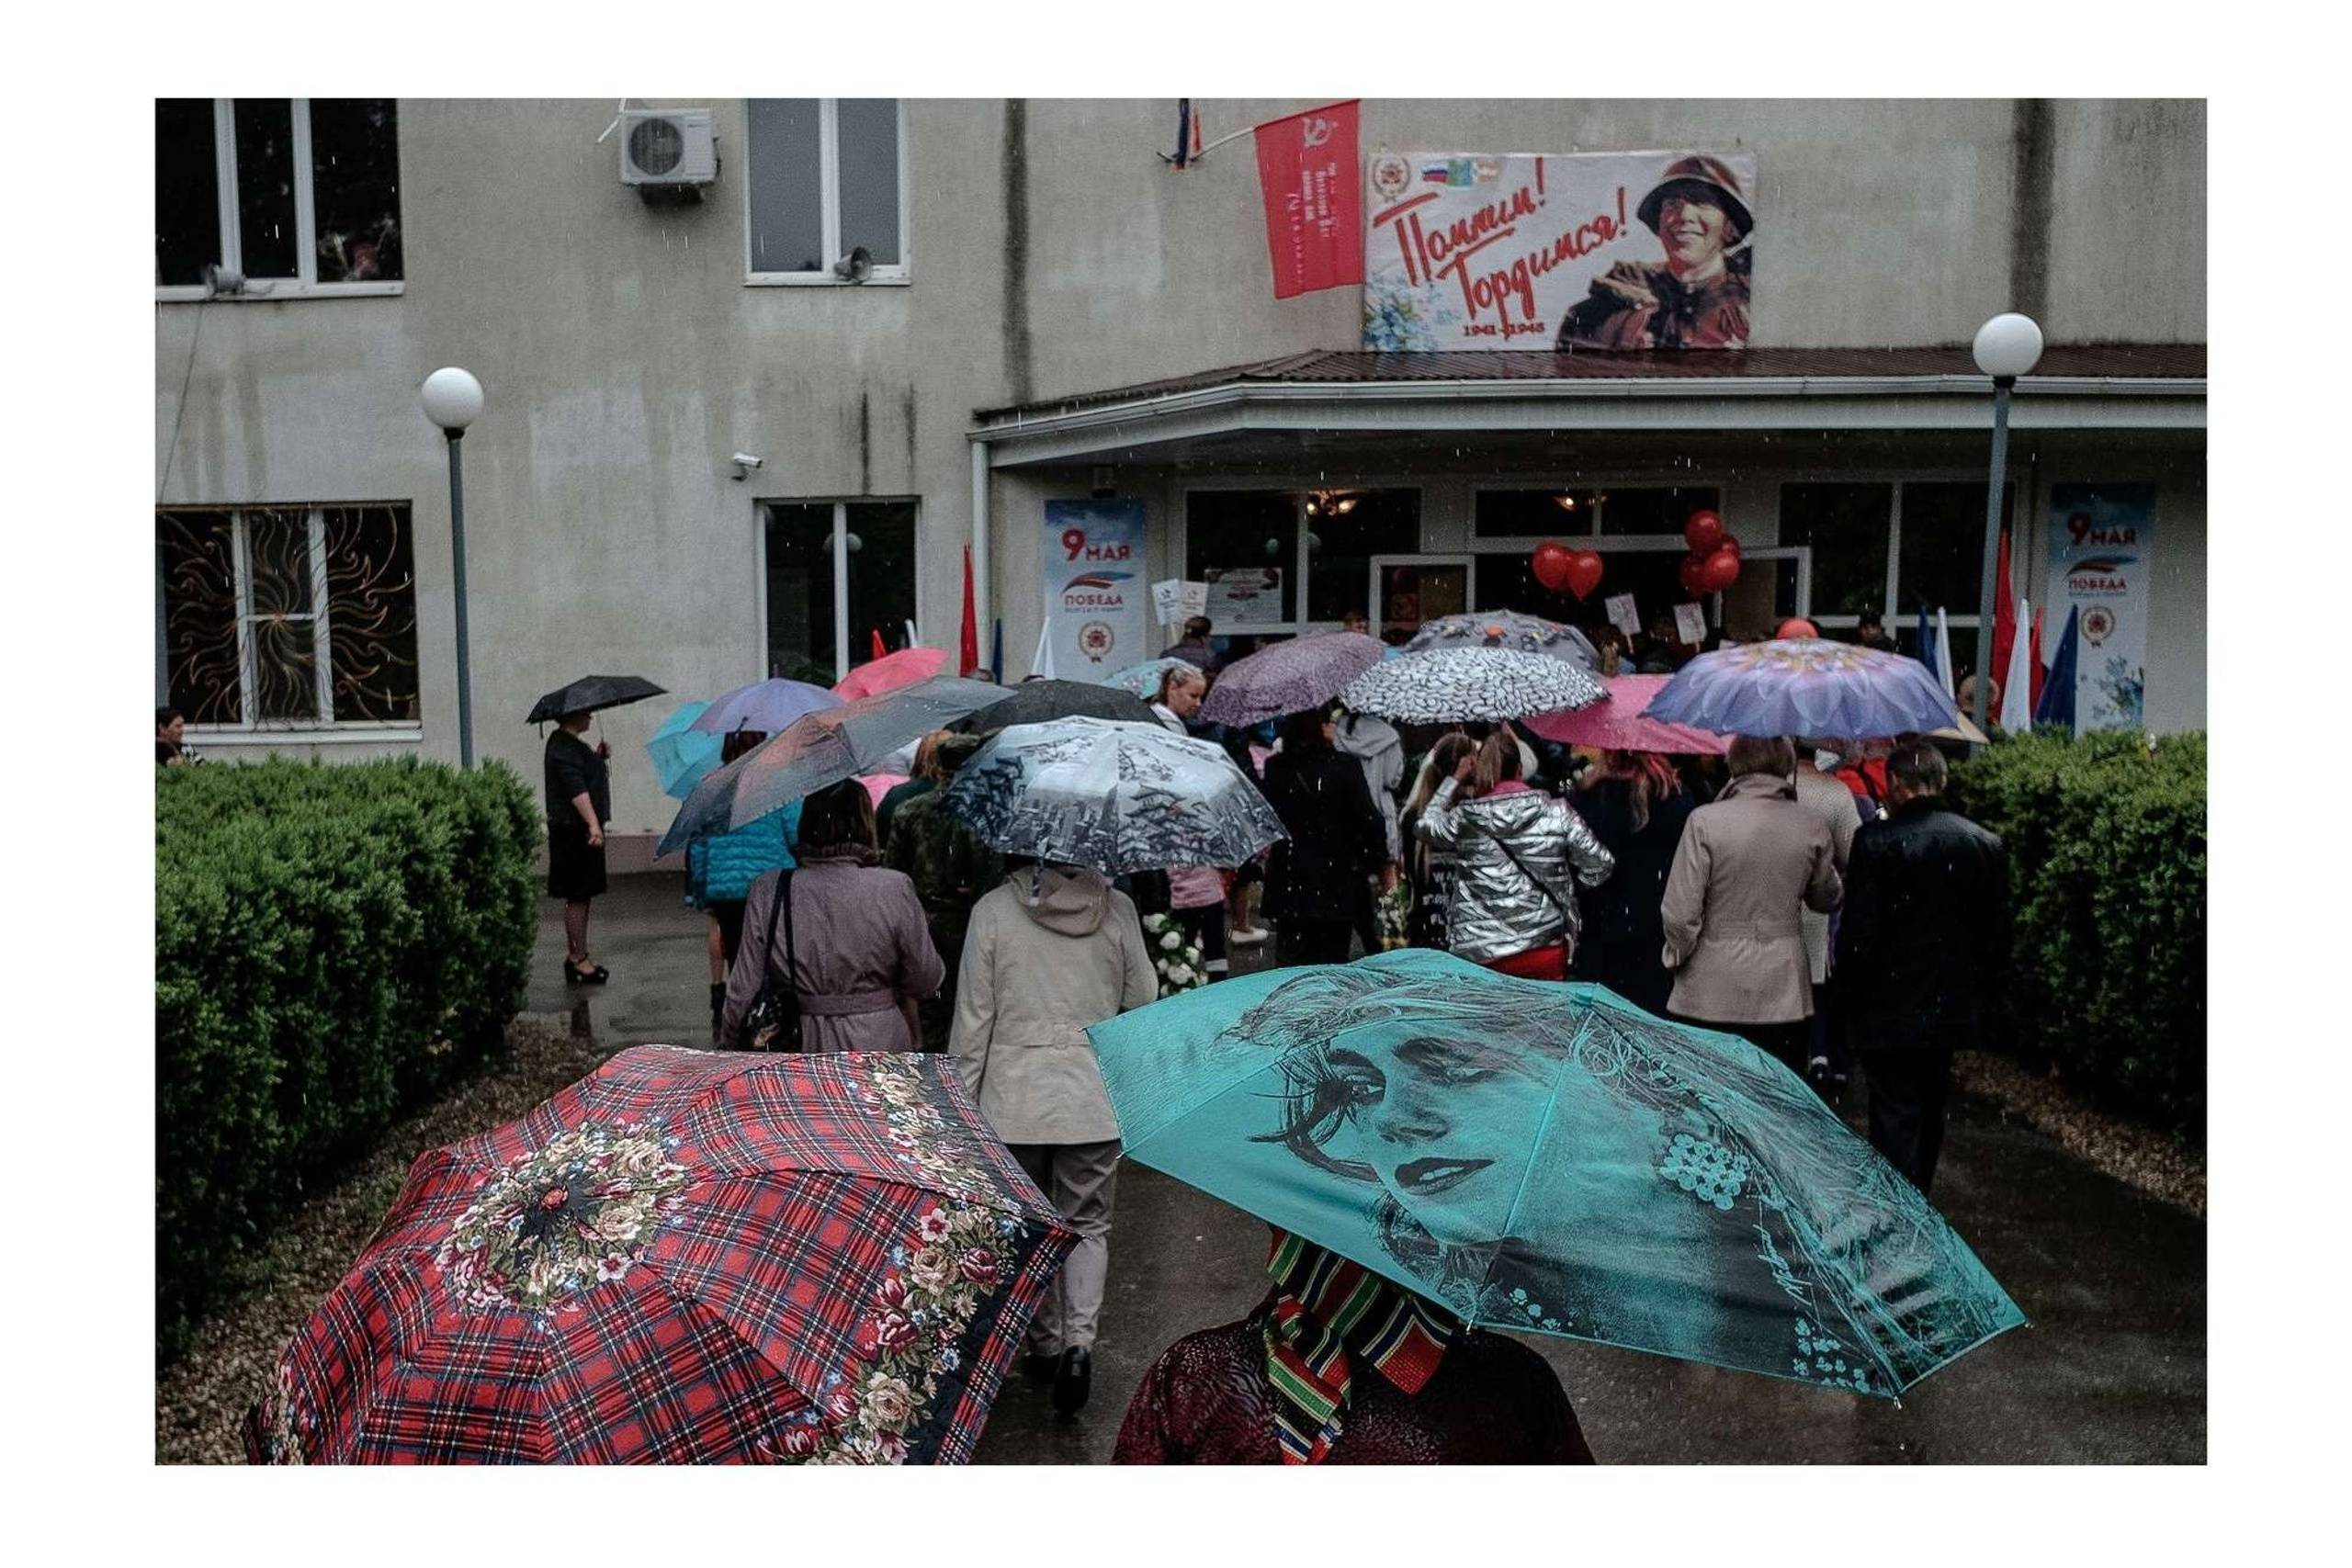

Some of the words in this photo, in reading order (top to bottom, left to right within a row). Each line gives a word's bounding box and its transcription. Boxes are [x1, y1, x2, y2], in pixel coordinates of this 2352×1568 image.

[1374, 156, 1545, 286] Помним!
[1438, 187, 1628, 340] Гордимся!
[1062, 529, 1085, 561] 9
[1086, 546, 1130, 560] МАЯ
[2068, 513, 2090, 546] 9
[2092, 528, 2135, 544] МАЯ
[1065, 594, 1123, 605] ПОБЕДА
[2068, 578, 2127, 590] ПОБЕДА
